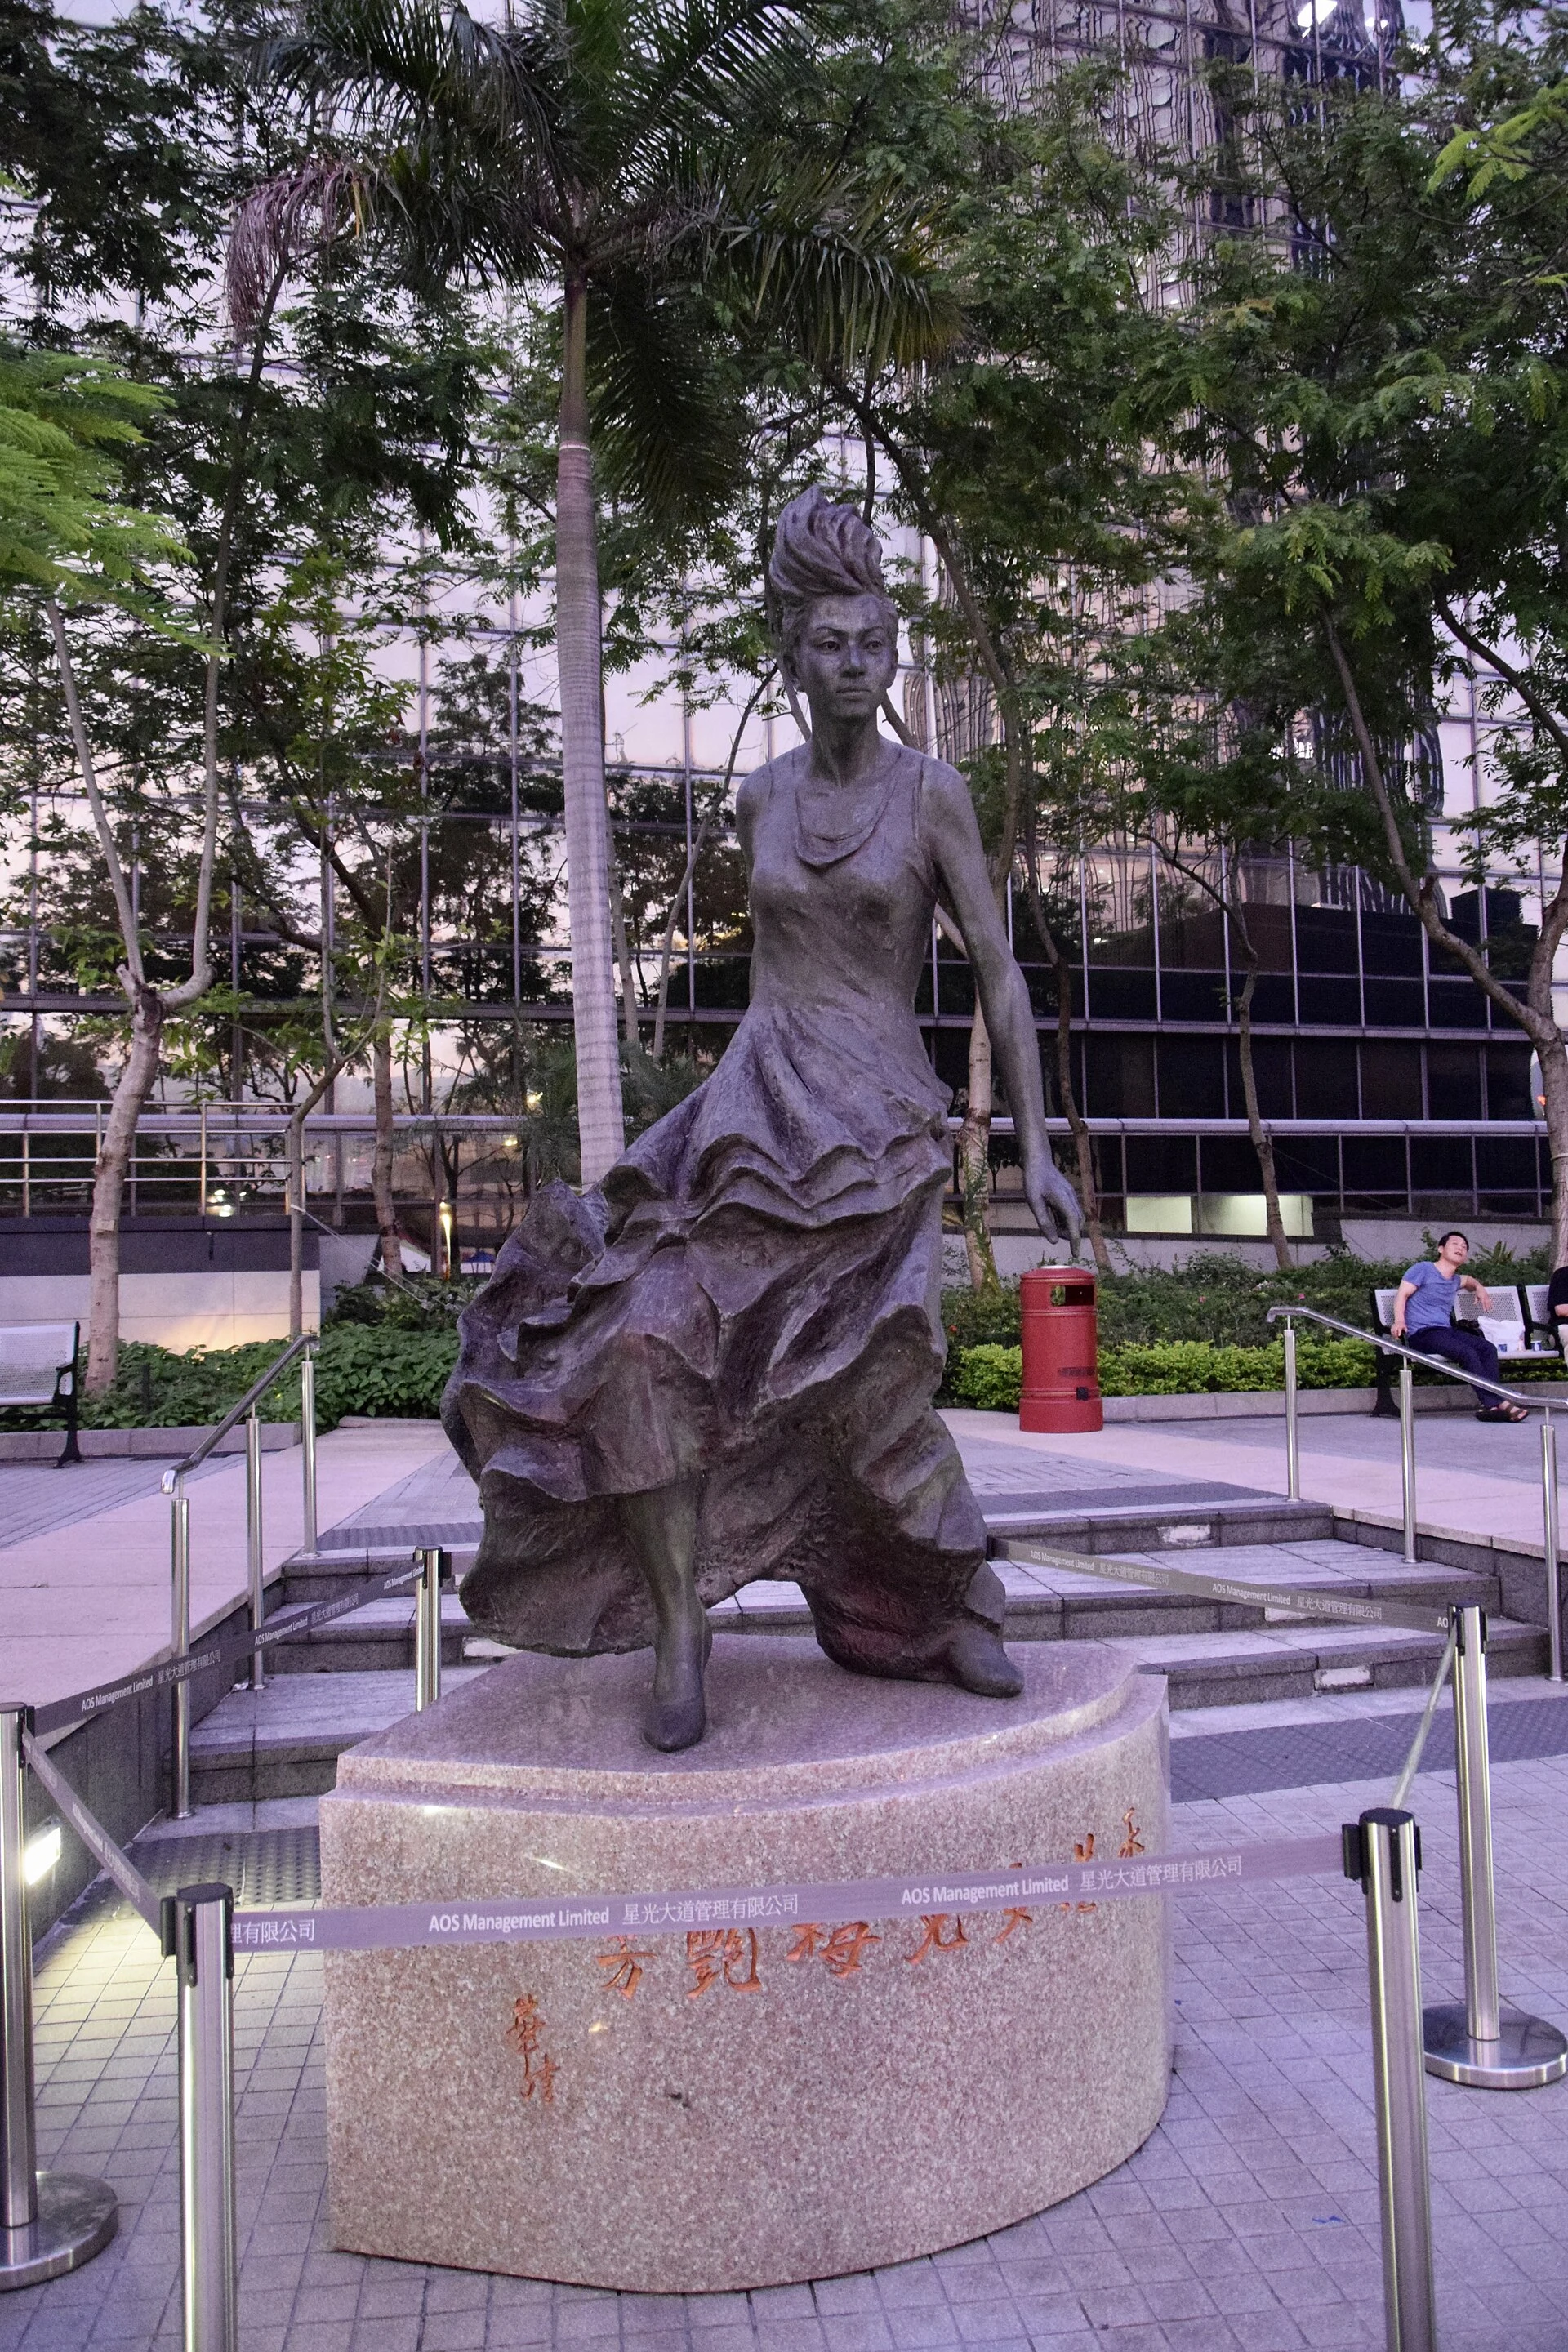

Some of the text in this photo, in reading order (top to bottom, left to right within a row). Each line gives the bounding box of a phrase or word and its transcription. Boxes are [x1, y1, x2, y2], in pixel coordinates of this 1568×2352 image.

[1030, 1550, 1094, 1571] AOS Management Limited
[1212, 1583, 1290, 1606] AOS Management Limited
[82, 1676, 153, 1712] AOS Management Limited
[1080, 1855, 1242, 1891] 星光大道管理有限公司
[902, 1874, 1069, 1904] AOS Management Limited
[429, 1907, 610, 1933] AOS Management Limited
[622, 1893, 798, 1926] 星光大道管理有限公司
